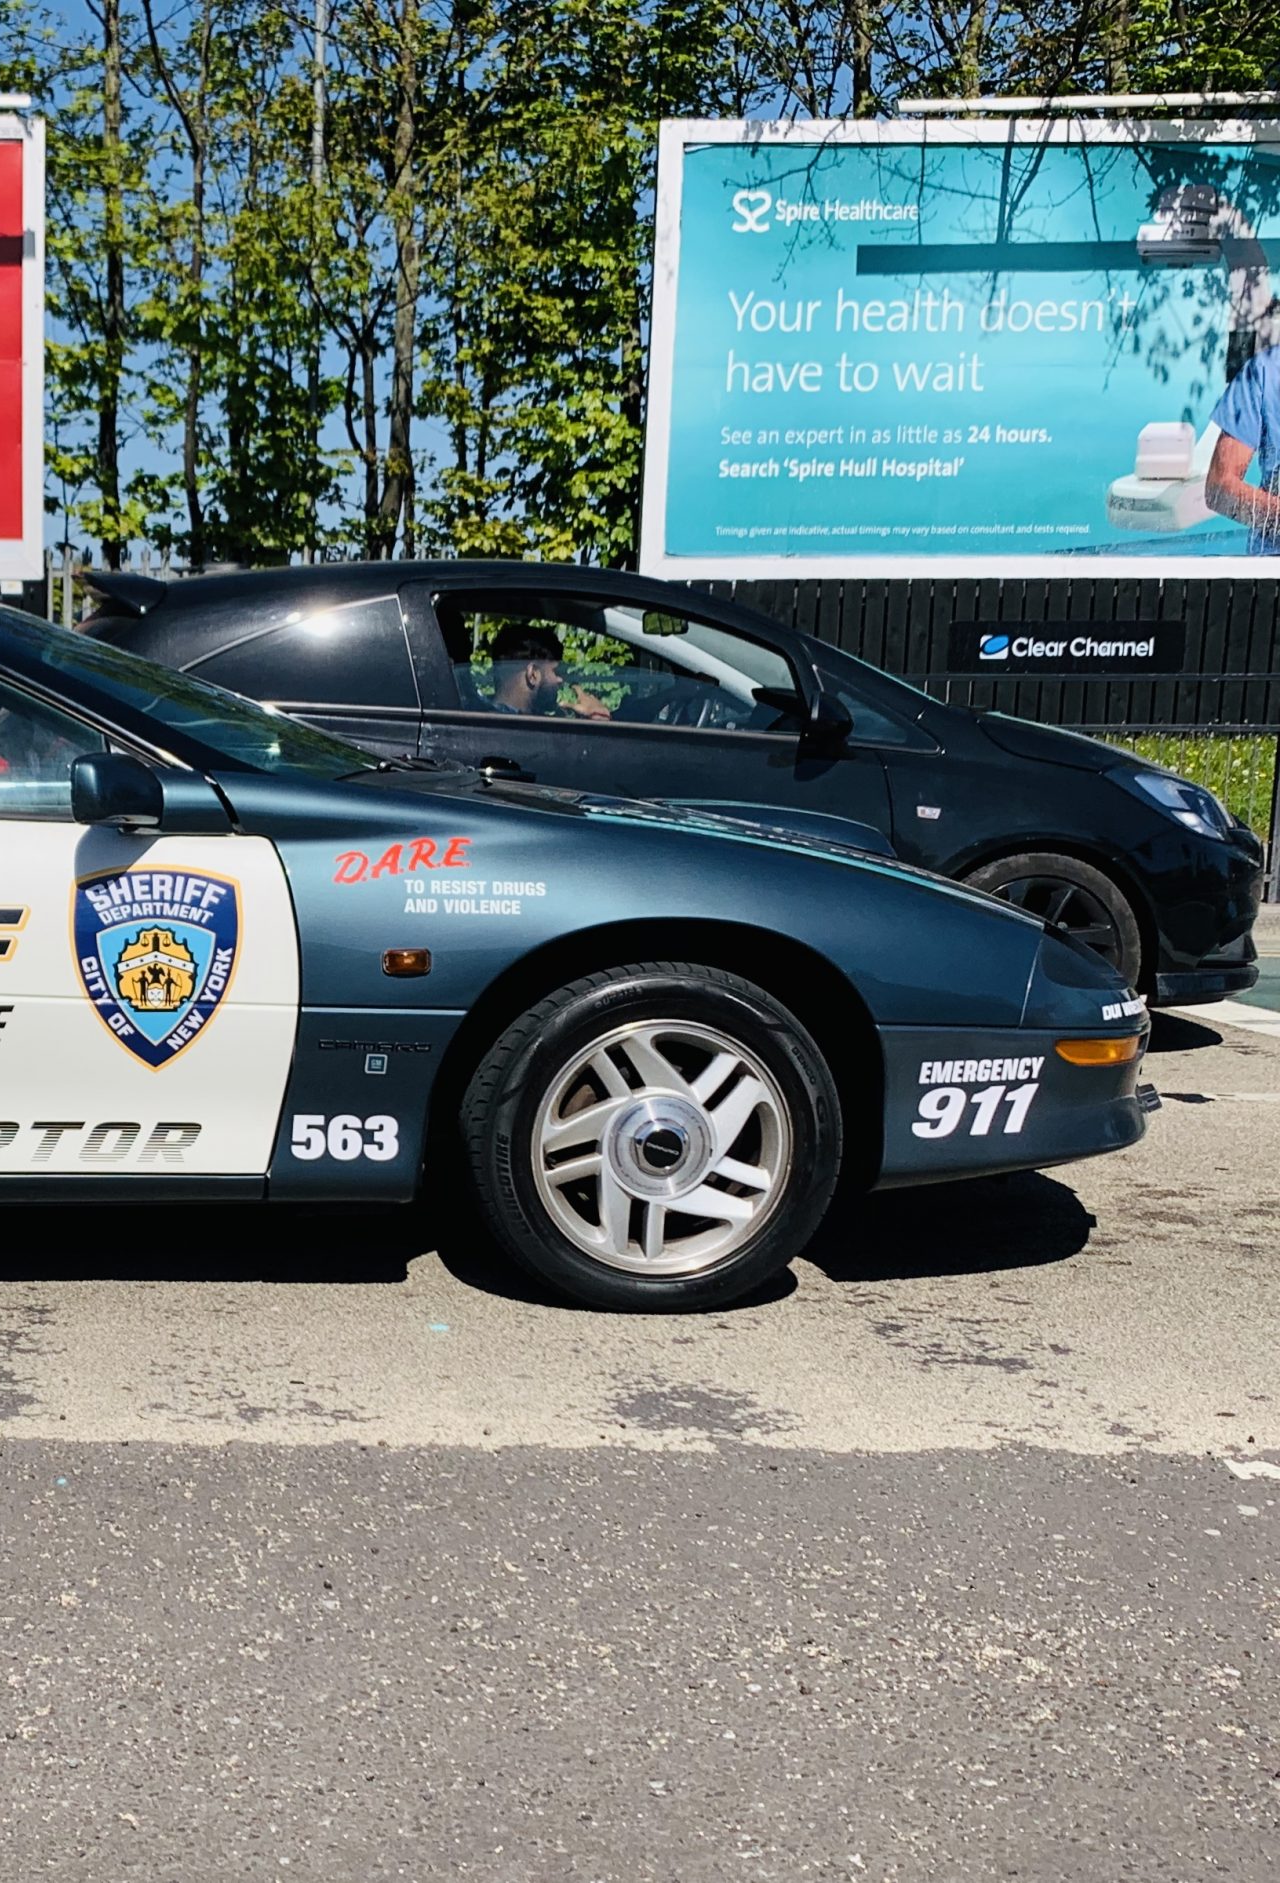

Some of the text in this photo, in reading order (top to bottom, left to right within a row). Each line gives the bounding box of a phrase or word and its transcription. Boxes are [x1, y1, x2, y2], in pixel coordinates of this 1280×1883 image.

[775, 198, 919, 227] Spire Healthcare
[728, 287, 1136, 333] Your health doesn't
[725, 349, 985, 393] have to wait
[720, 424, 1053, 449] See an expert in as little as 24 hours.
[719, 457, 780, 478] Search
[839, 456, 877, 478] Hull
[715, 526, 748, 538] Timings
[749, 526, 771, 538] given
[773, 527, 787, 536] are
[831, 525, 858, 536] actual
[859, 525, 891, 538] timings
[892, 526, 910, 537] may
[911, 526, 929, 537] vary
[930, 524, 956, 535] based
[957, 526, 968, 534] on
[970, 524, 1014, 535] consultant
[1016, 524, 1032, 534] and
[1033, 524, 1055, 534] tests
[1011, 636, 1155, 658] Clear Channel
[85, 873, 227, 912] SHERIFF
[404, 879, 547, 897] TO RESIST DRUGS
[98, 902, 215, 926] DEPARTMENT
[404, 898, 522, 916] AND VIOLENCE
[81, 955, 135, 1038] CITY OF
[166, 947, 233, 1051] NEW YORK
[1101, 1002, 1123, 1021] DUI
[918, 1056, 1046, 1084] EMERGENCY
[911, 1083, 1040, 1139] 911
[290, 1114, 400, 1161] 563
